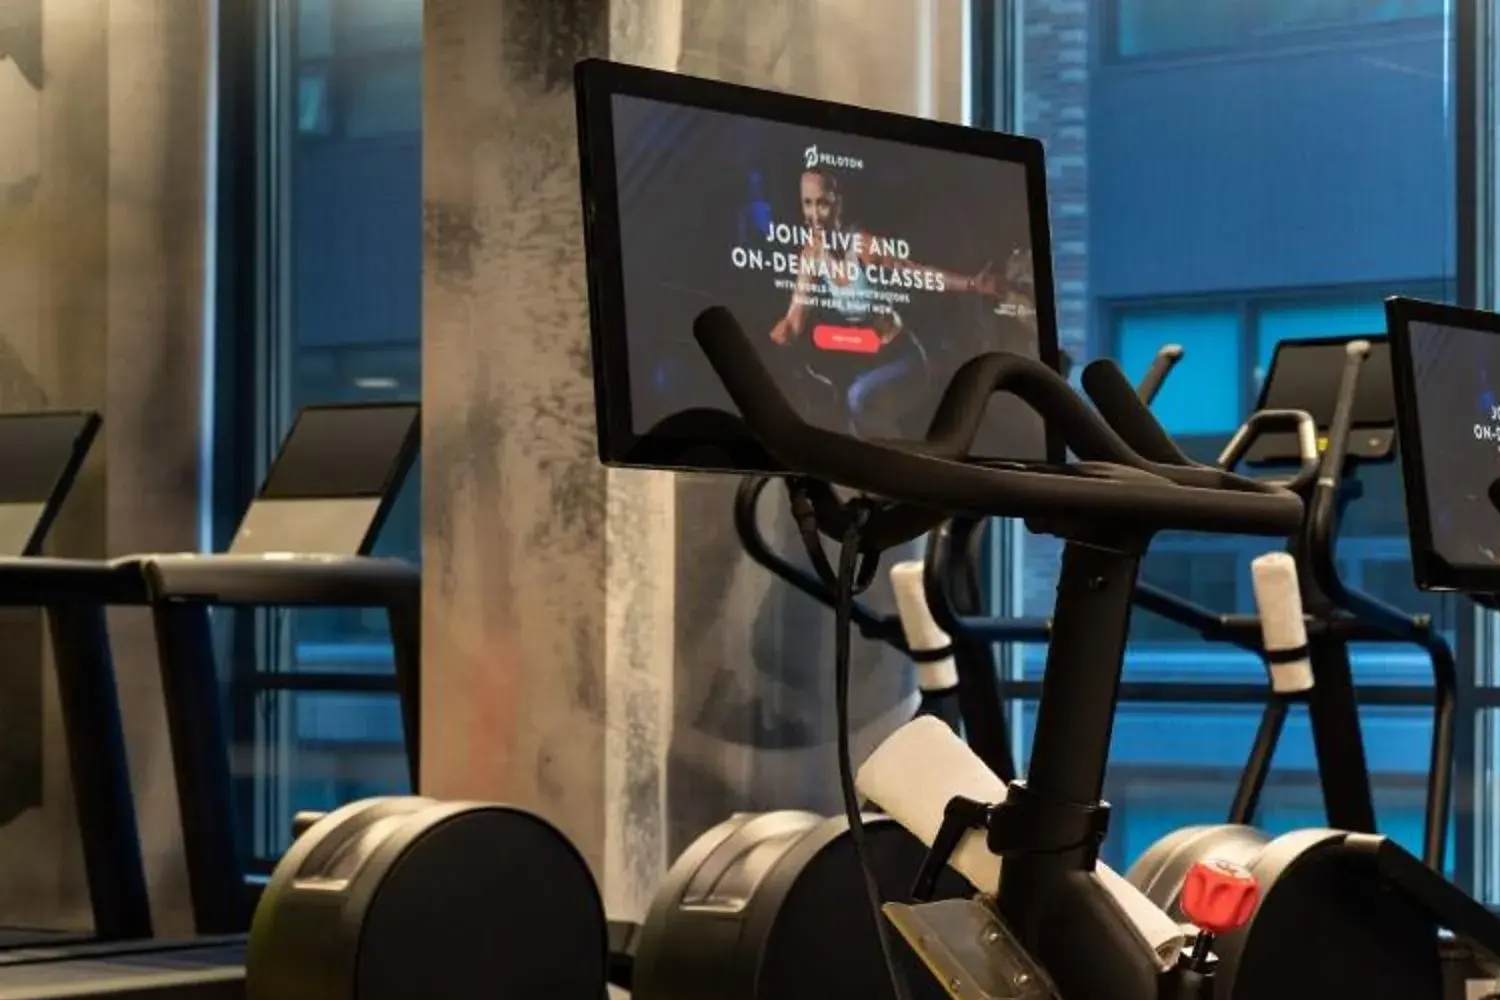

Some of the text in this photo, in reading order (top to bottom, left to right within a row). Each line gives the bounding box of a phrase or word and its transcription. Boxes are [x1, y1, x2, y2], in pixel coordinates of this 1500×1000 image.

[820, 152, 864, 169] PELOTON
[766, 221, 910, 260] JOIN LIVE AND
[731, 246, 860, 282] ON-DEMAND
[866, 265, 946, 293] CLASSES
